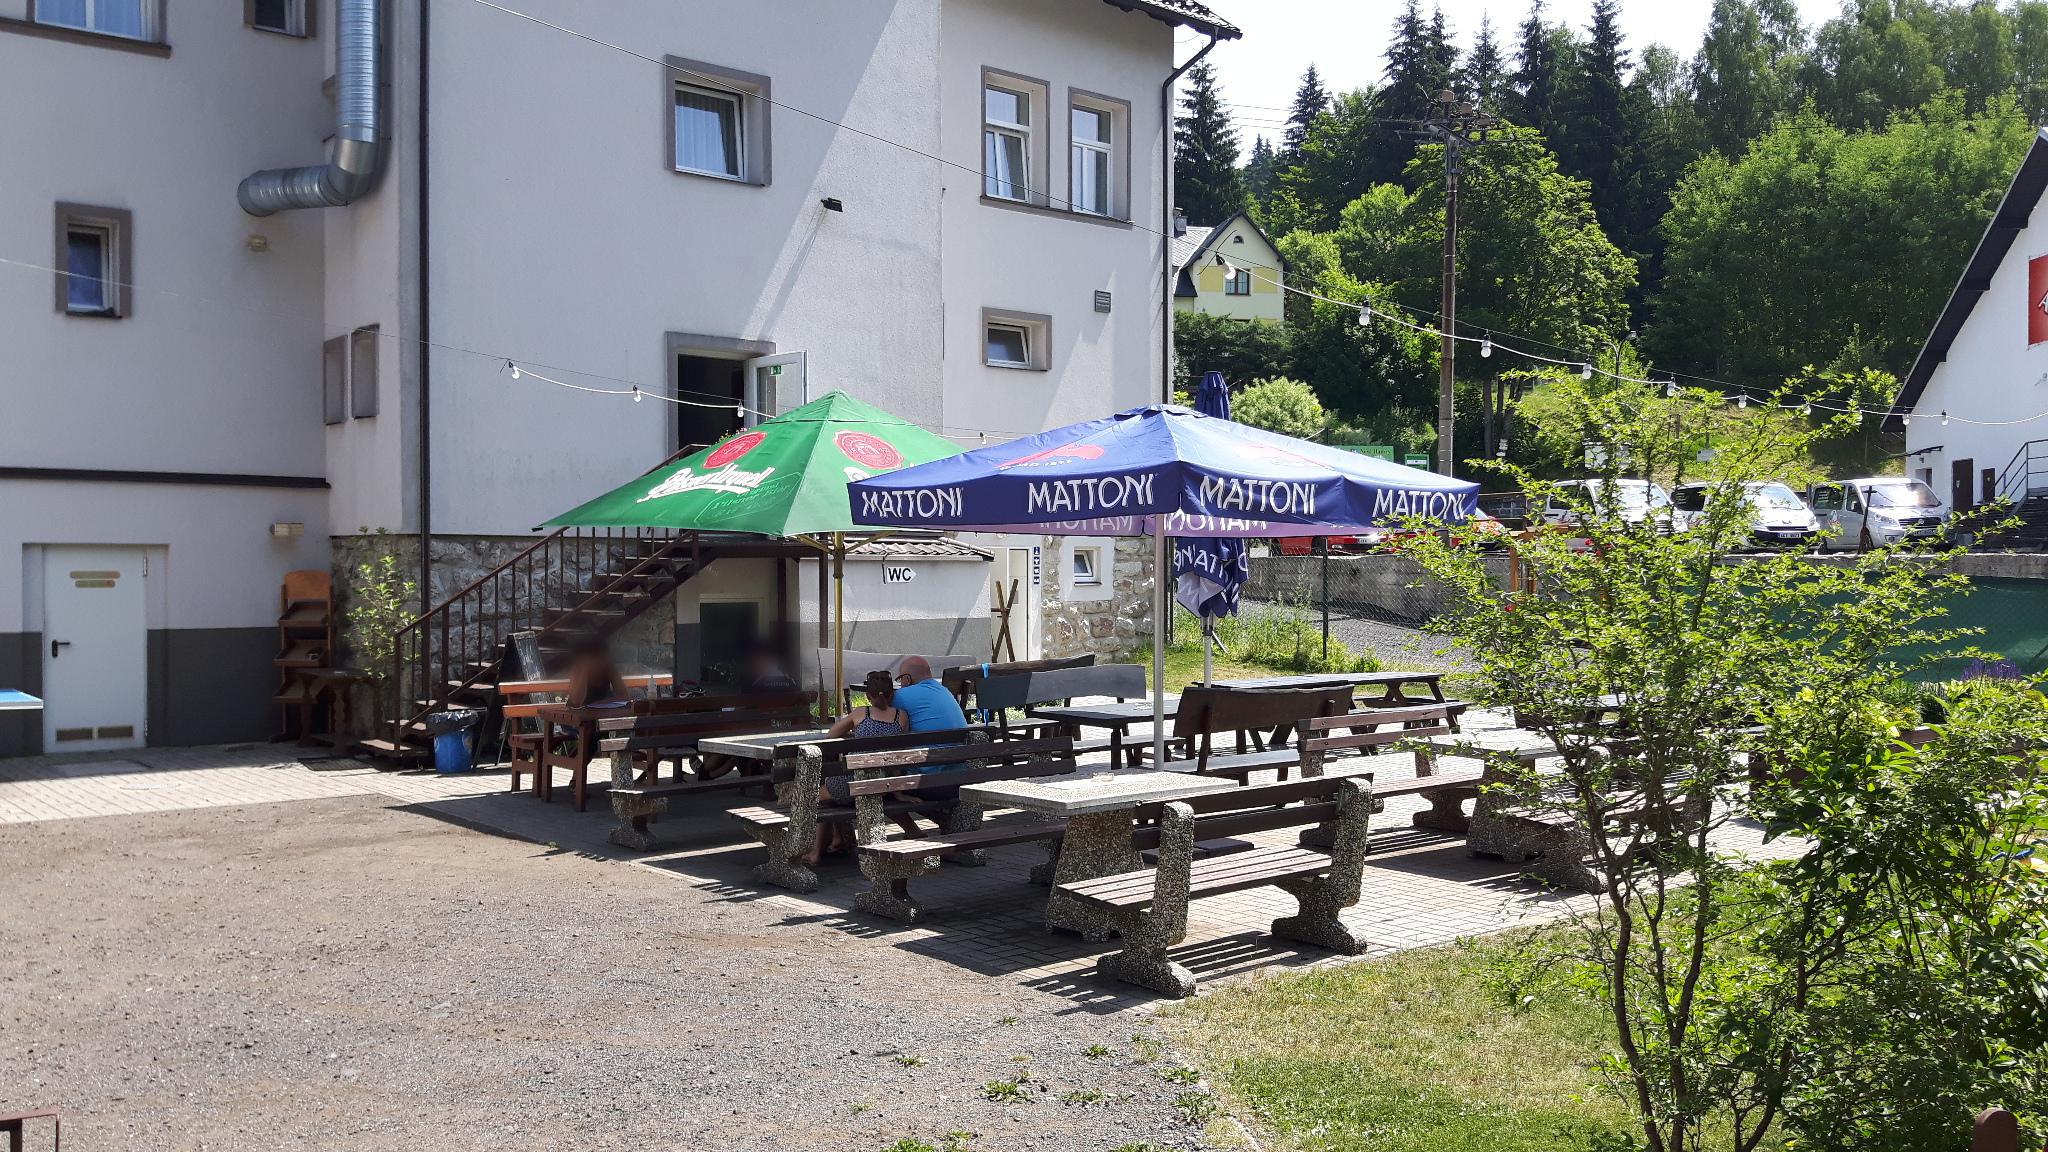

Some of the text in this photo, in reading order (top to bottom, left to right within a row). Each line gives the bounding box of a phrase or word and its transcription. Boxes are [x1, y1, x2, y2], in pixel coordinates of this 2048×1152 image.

[861, 487, 962, 519] MATTONI
[1027, 474, 1154, 514] MATTONI
[1199, 475, 1316, 515] MATTONI
[1372, 488, 1466, 520] MATTONI
[888, 567, 912, 582] WC
